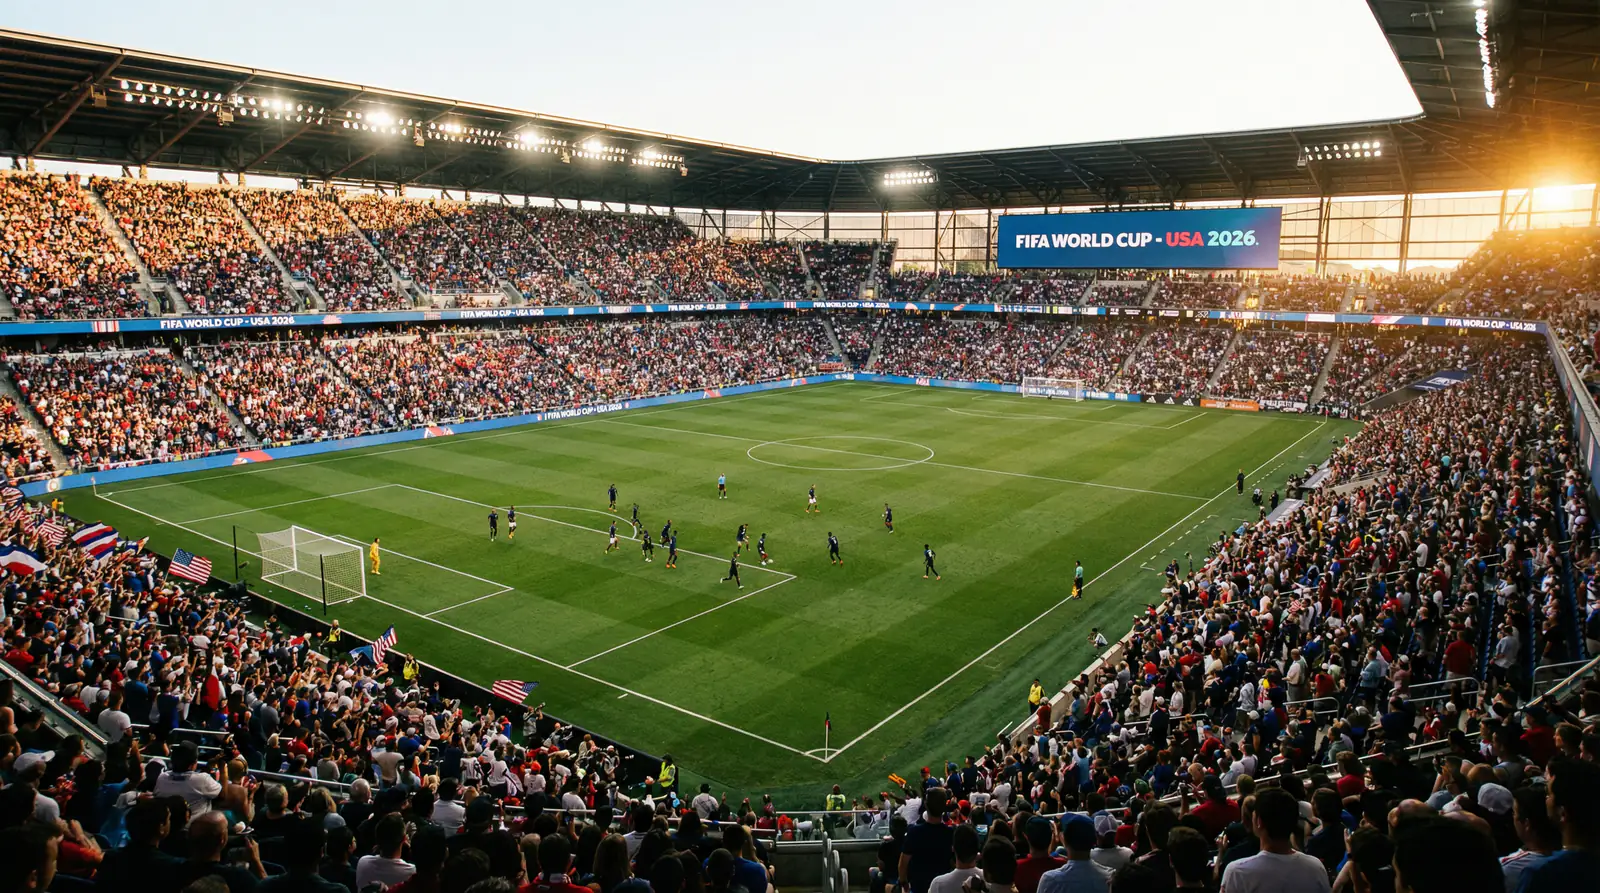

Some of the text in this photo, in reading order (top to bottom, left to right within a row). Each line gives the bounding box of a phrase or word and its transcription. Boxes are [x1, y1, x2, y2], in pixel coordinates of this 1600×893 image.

[1015, 233, 1049, 248] FIFA
[1052, 233, 1113, 248] WORLD
[1116, 232, 1152, 247] CUP
[1166, 231, 1204, 247] USA
[160, 319, 183, 329] FIFA
[184, 318, 222, 328] WORLD
[223, 317, 243, 327] CUP
[250, 316, 271, 326] USA
[271, 316, 295, 325] 2026
